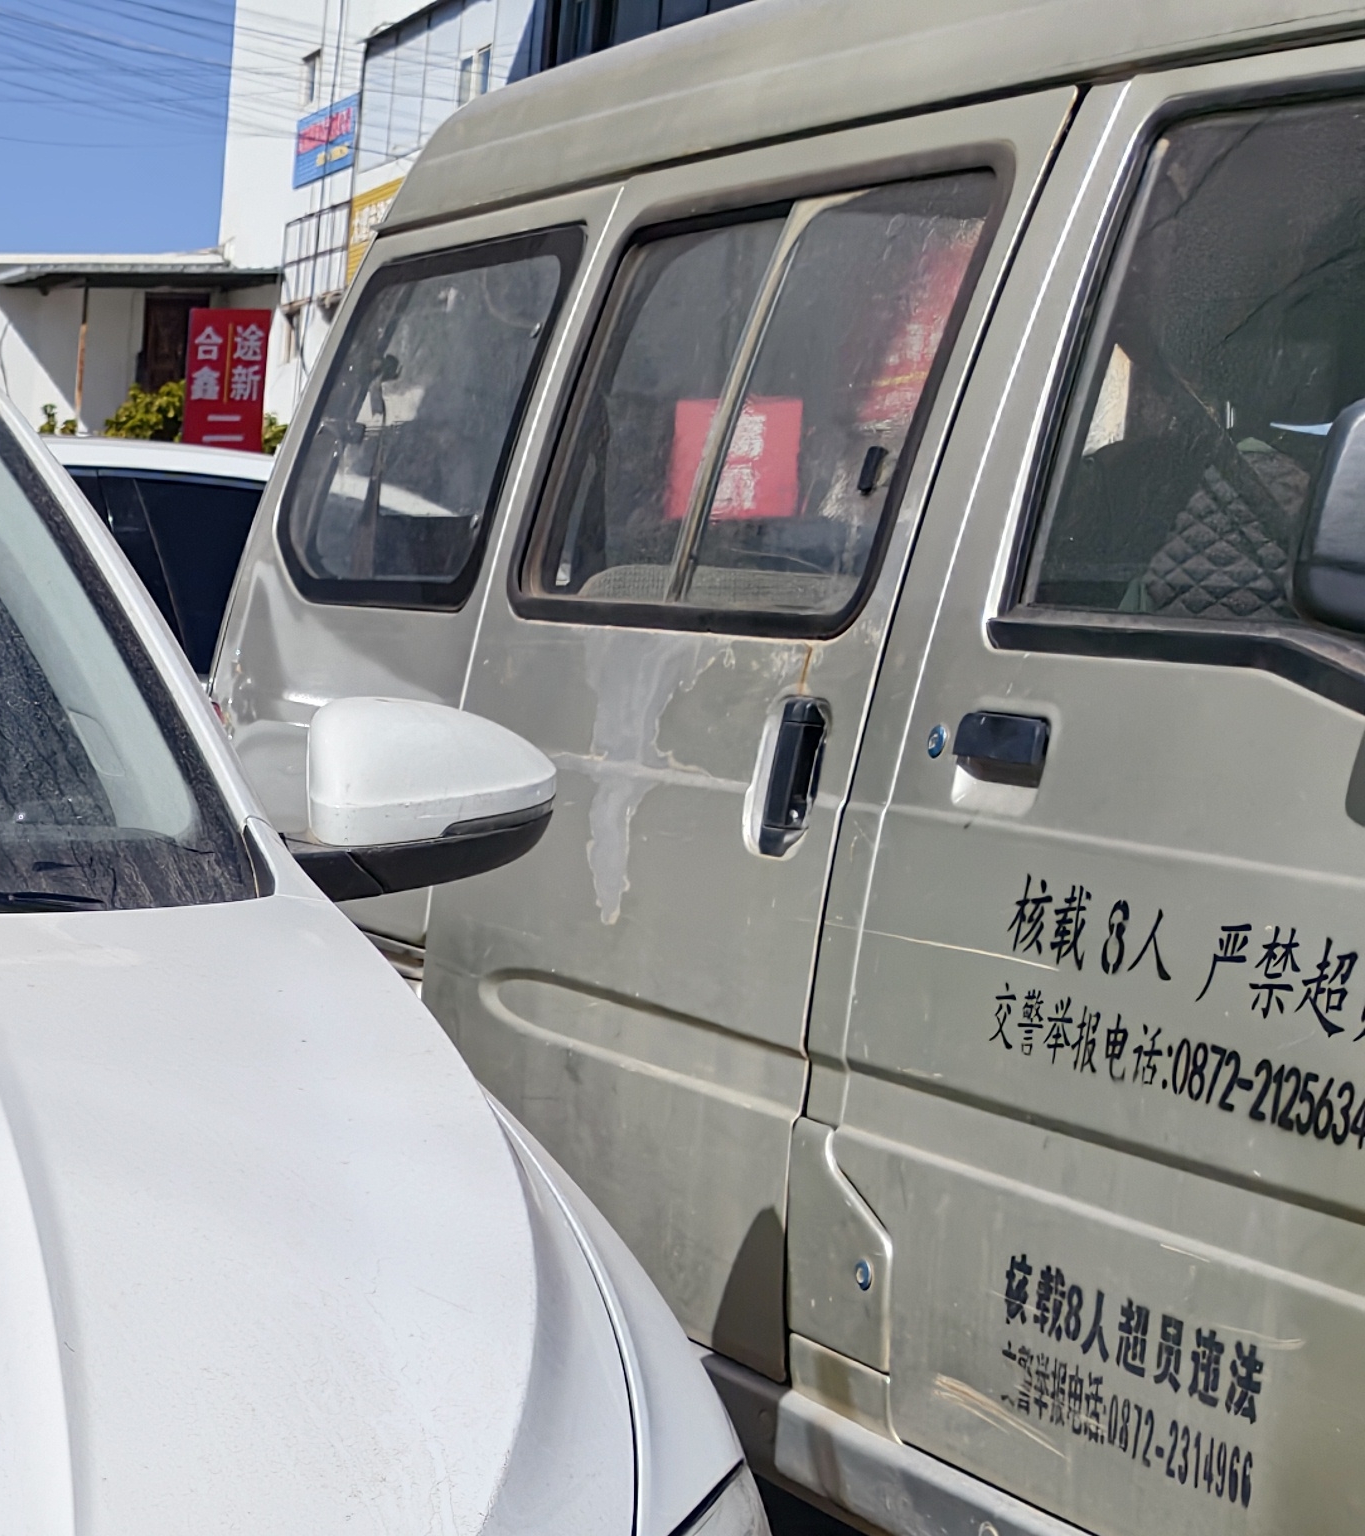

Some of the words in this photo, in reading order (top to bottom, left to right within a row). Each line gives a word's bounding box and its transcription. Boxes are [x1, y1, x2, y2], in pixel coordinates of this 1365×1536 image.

[190, 325, 224, 401] 合鑫
[230, 322, 265, 401] 途新
[1195, 922, 1365, 1042] 严禁超
